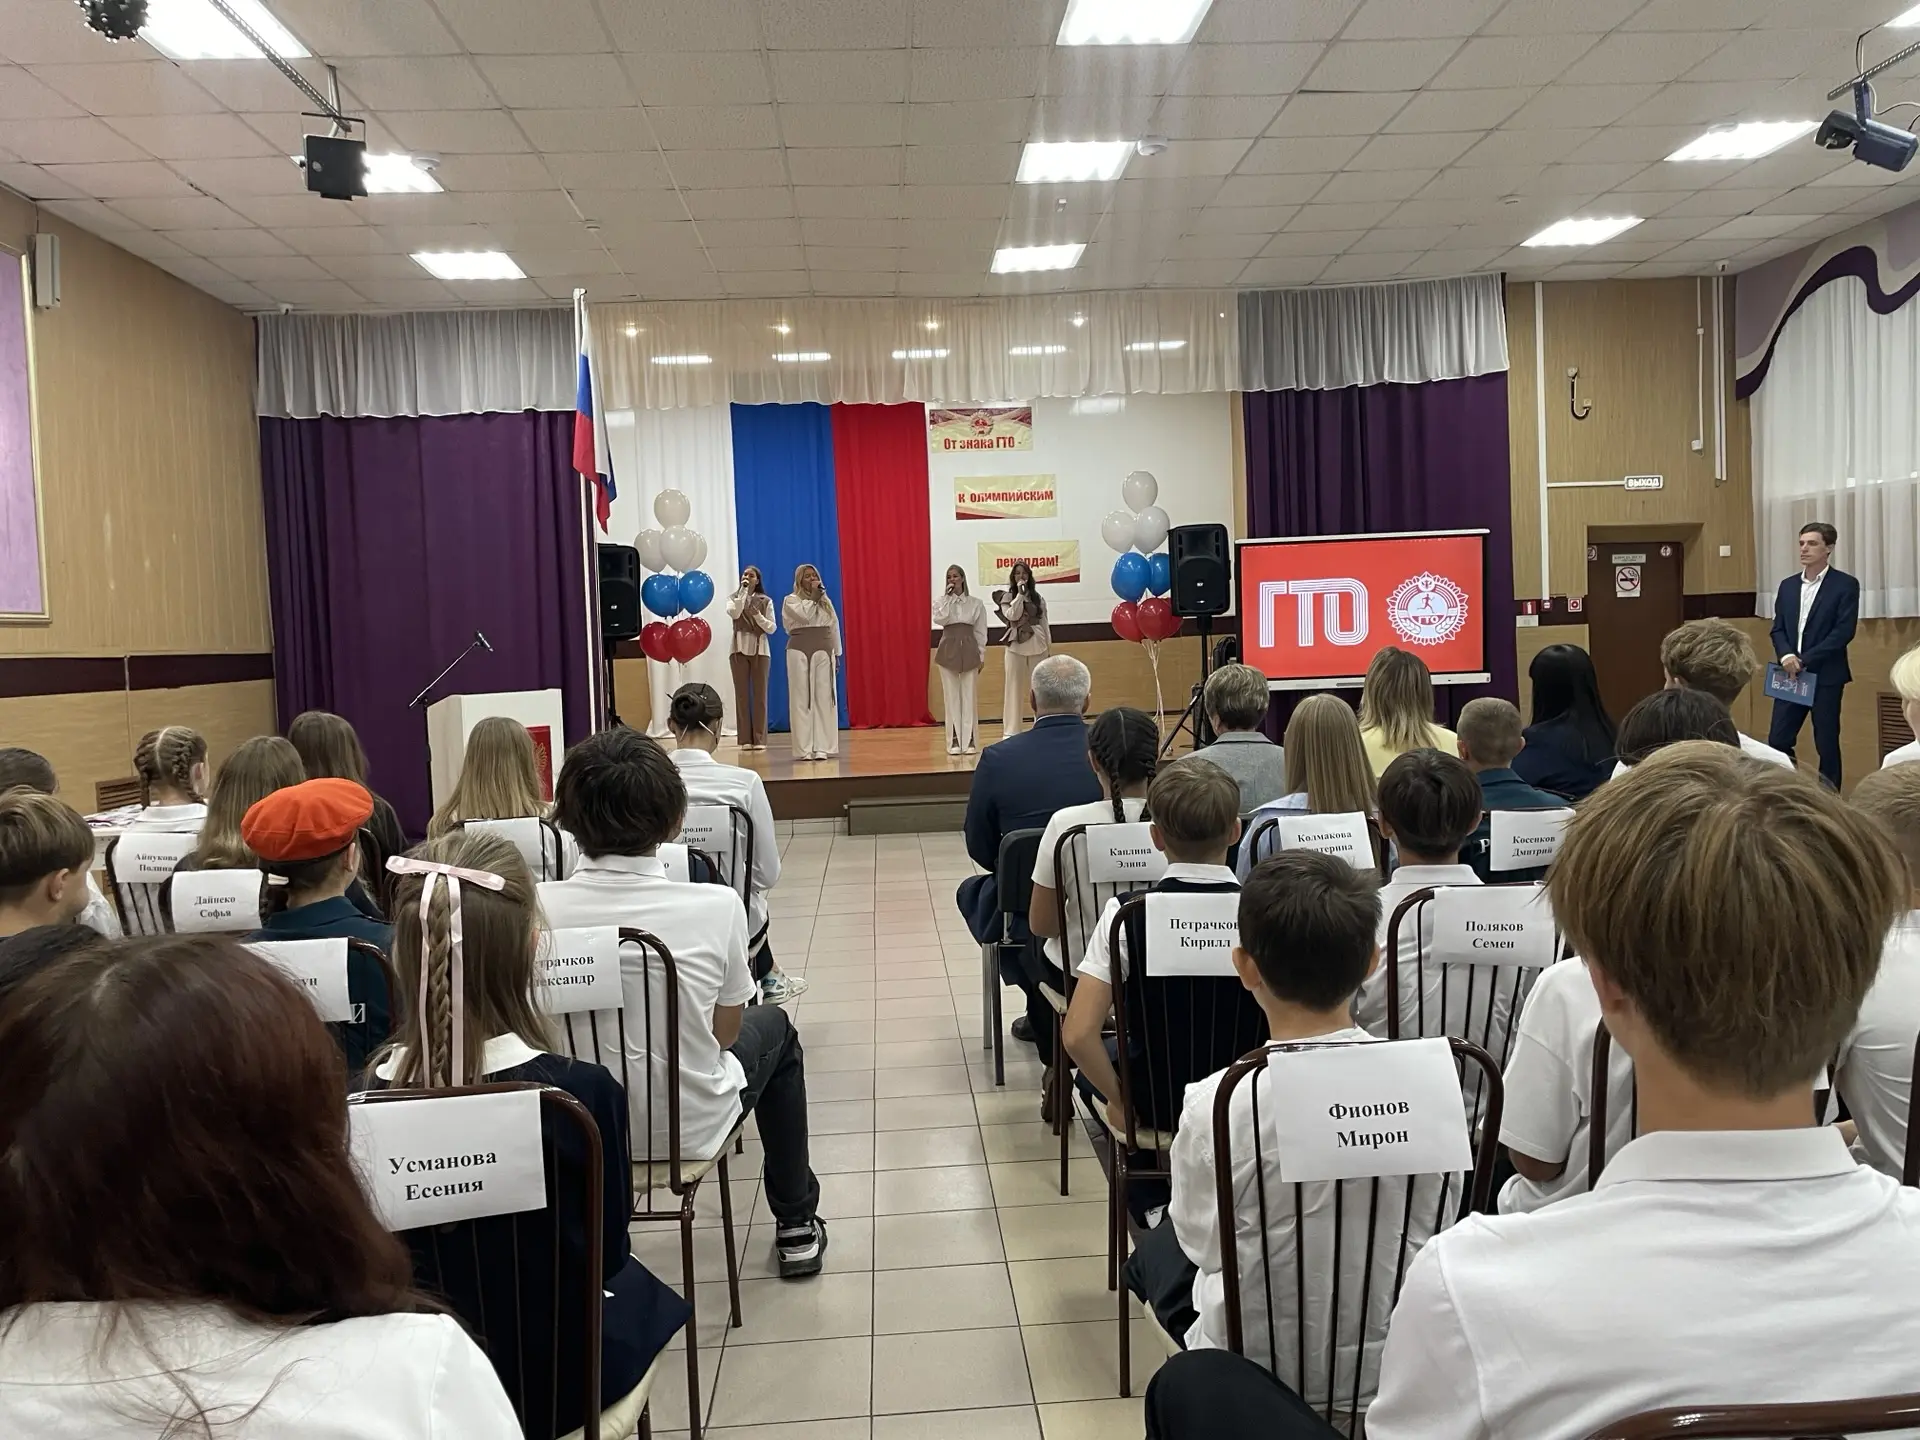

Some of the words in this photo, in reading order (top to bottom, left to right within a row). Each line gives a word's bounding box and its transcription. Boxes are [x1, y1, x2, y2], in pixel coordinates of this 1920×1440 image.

[944, 438, 957, 450] От
[960, 438, 993, 449] знака
[996, 436, 1015, 448] ГТО
[1627, 477, 1660, 488] ВЫХОД
[1259, 578, 1369, 648] ГТО
[1418, 615, 1440, 625] ГТО
[1298, 831, 1352, 843] Колмакова
[1513, 836, 1556, 844] Косенков
[1512, 848, 1553, 857] Дмитрий
[139, 864, 173, 872] Полина
[199, 909, 232, 919] Софья
[1465, 921, 1524, 932] Поляков
[1180, 937, 1231, 950] Кирилл
[1472, 938, 1514, 948] Семен
[1328, 1101, 1410, 1120] Фионов
[1336, 1130, 1409, 1150] Мирон
[388, 1152, 497, 1175] Усманова
[405, 1180, 484, 1201] Есения
